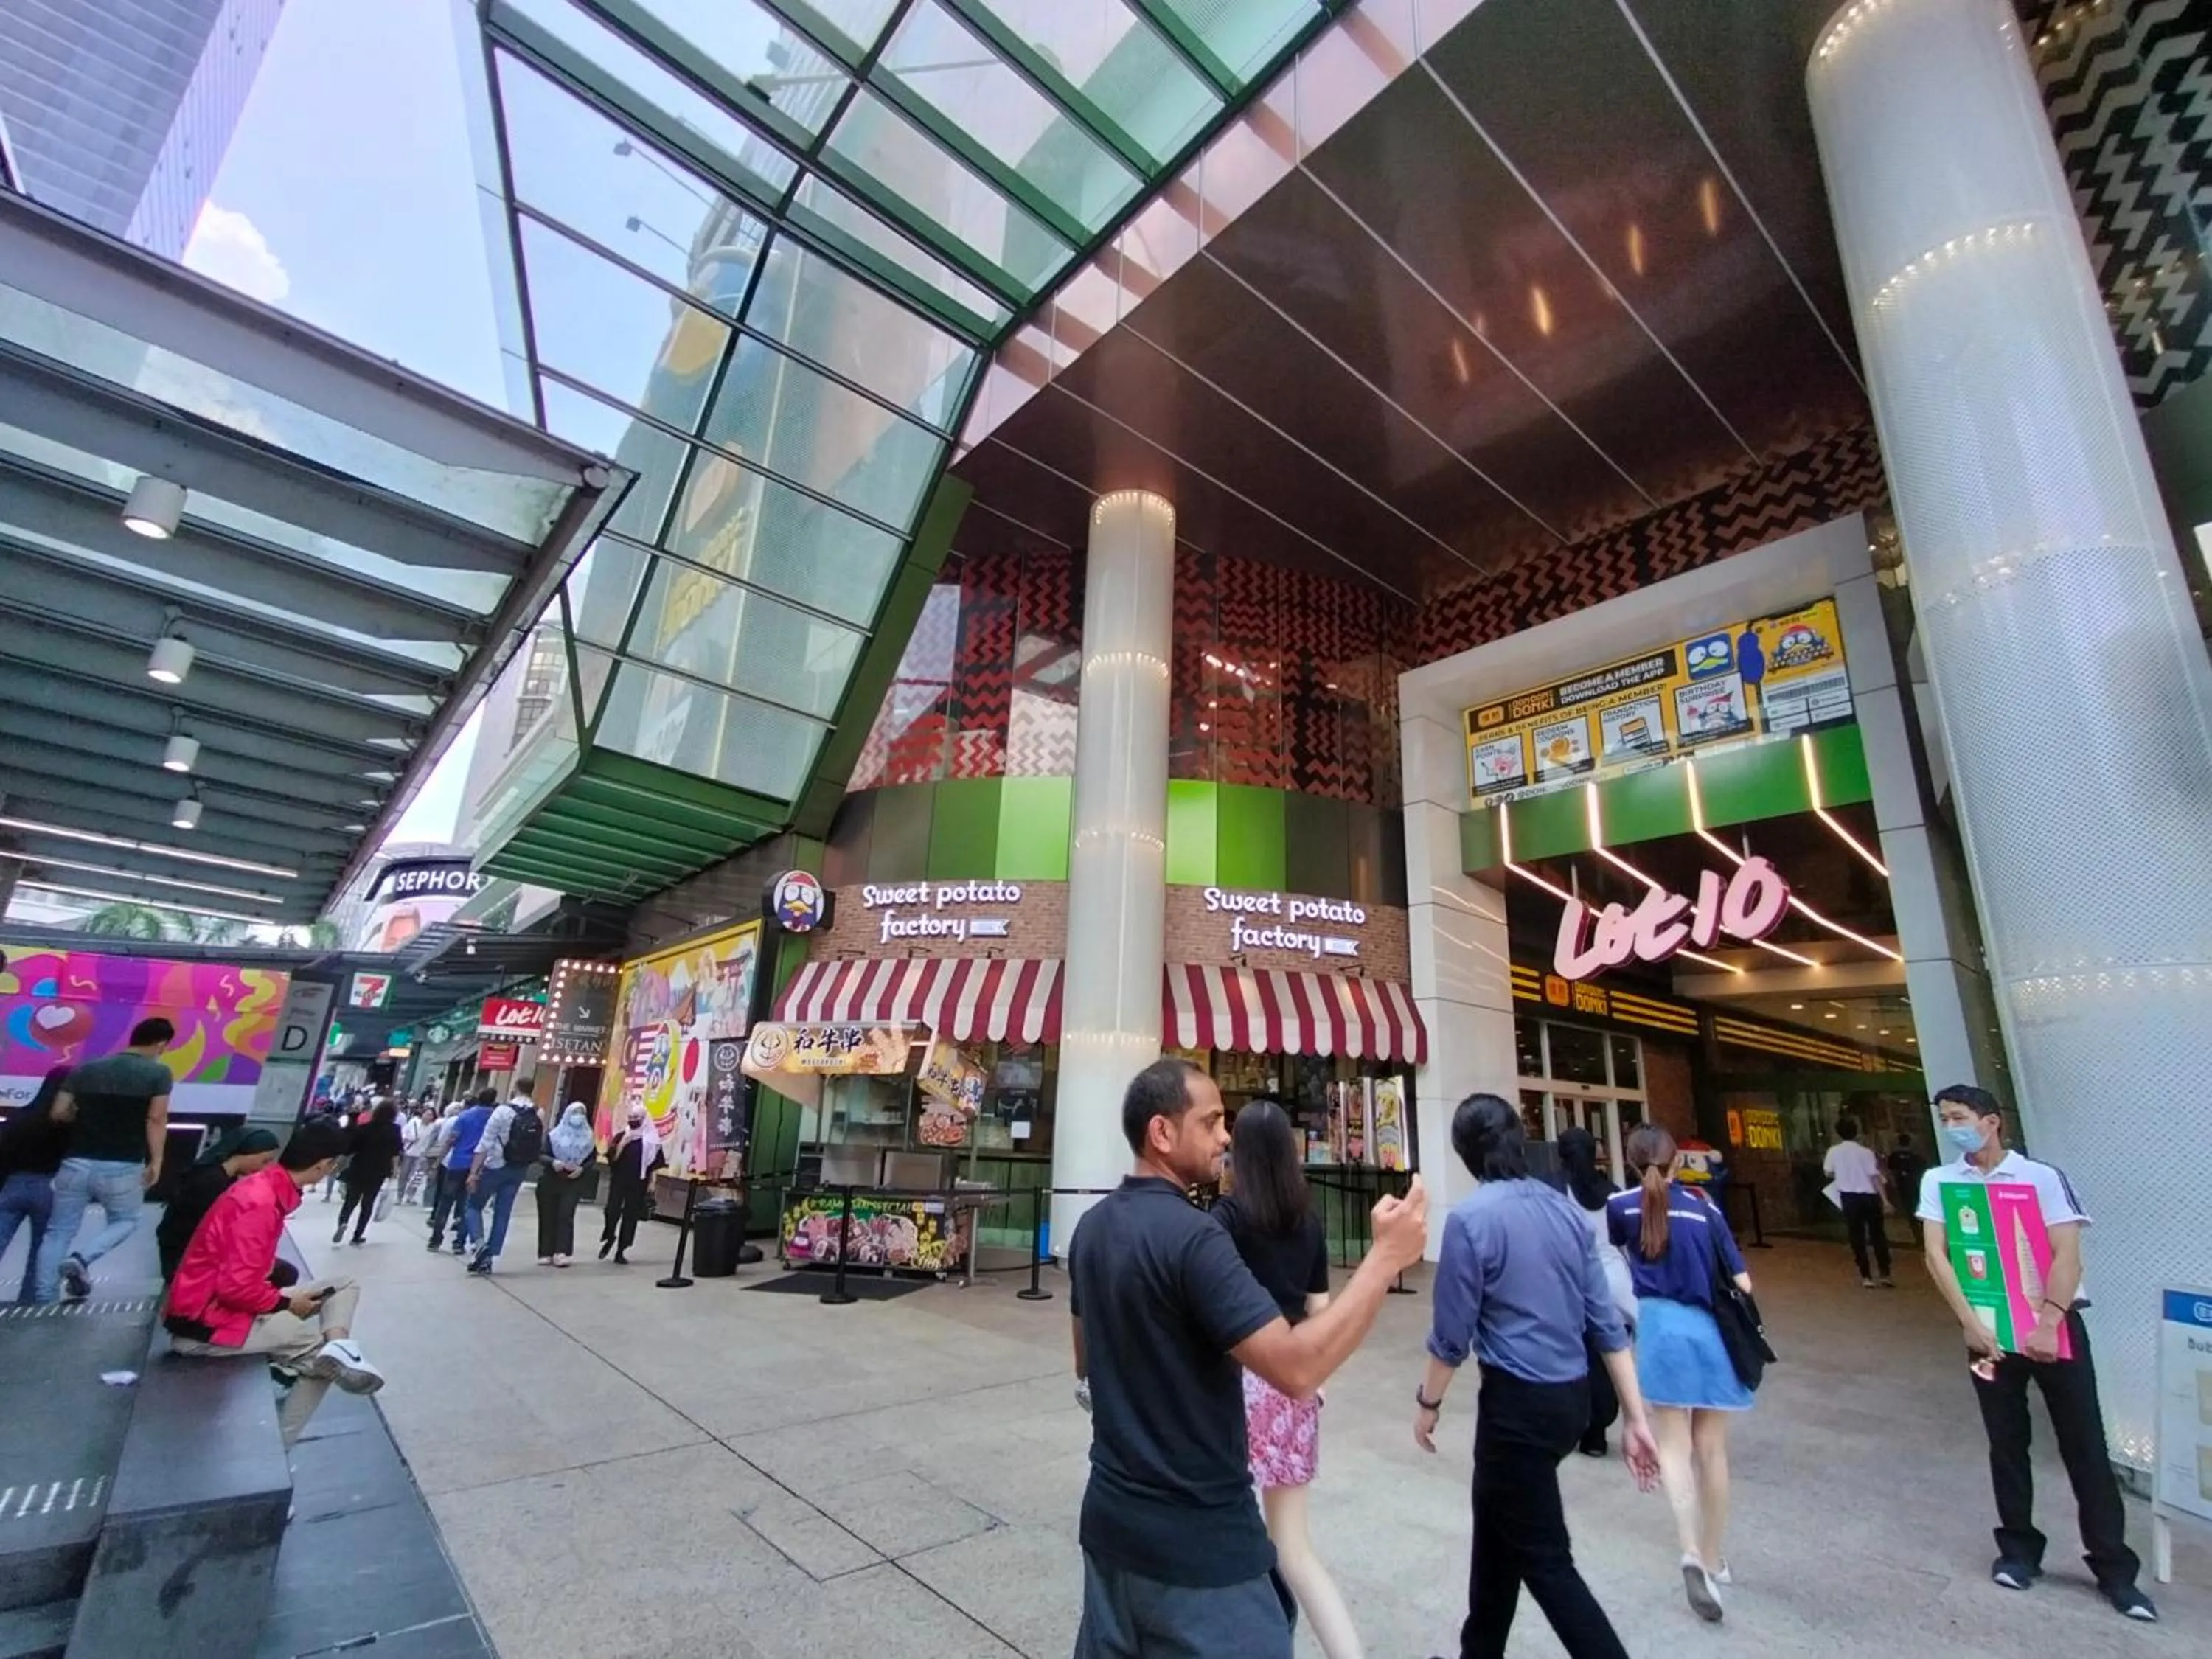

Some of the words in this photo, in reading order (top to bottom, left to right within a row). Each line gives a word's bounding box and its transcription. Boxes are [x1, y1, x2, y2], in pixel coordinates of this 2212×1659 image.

[1615, 658, 1665, 679] MEMBER
[1560, 681, 1618, 704] DOWNLOAD
[1620, 676, 1642, 686] THE
[1643, 667, 1665, 681] APP
[1679, 680, 1727, 697] BIRTHDAY
[396, 870, 481, 891] SEPHOR
[863, 881, 930, 908] Sweet
[936, 880, 1022, 911] potato
[1203, 887, 1281, 914] Sweet
[1289, 897, 1367, 925] potato
[880, 909, 967, 945] factory
[1231, 916, 1322, 959] factory
[281, 1025, 307, 1051] D
[551, 1037, 603, 1053] ISETAN
[794, 1027, 863, 1054] 和牛串
